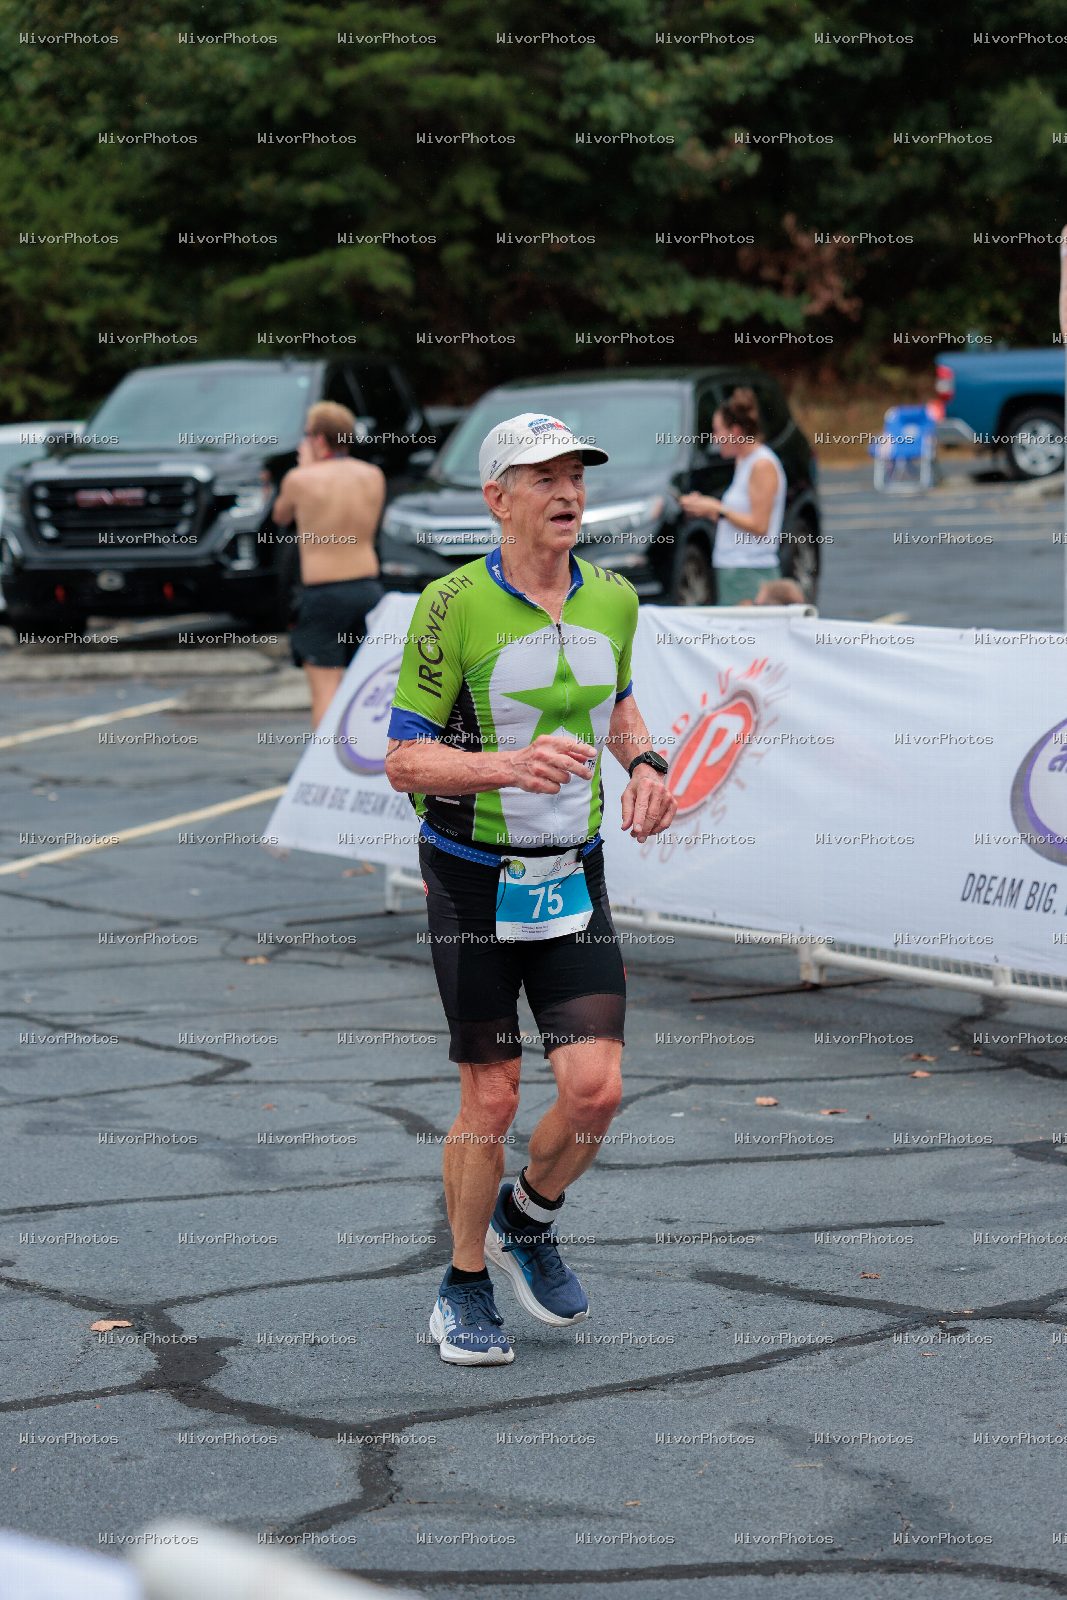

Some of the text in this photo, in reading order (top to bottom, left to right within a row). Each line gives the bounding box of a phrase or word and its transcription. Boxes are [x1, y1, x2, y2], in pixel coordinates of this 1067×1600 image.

[528, 882, 564, 919] 75
[961, 872, 1024, 909] DREAM
[1024, 880, 1058, 915] BIG.
